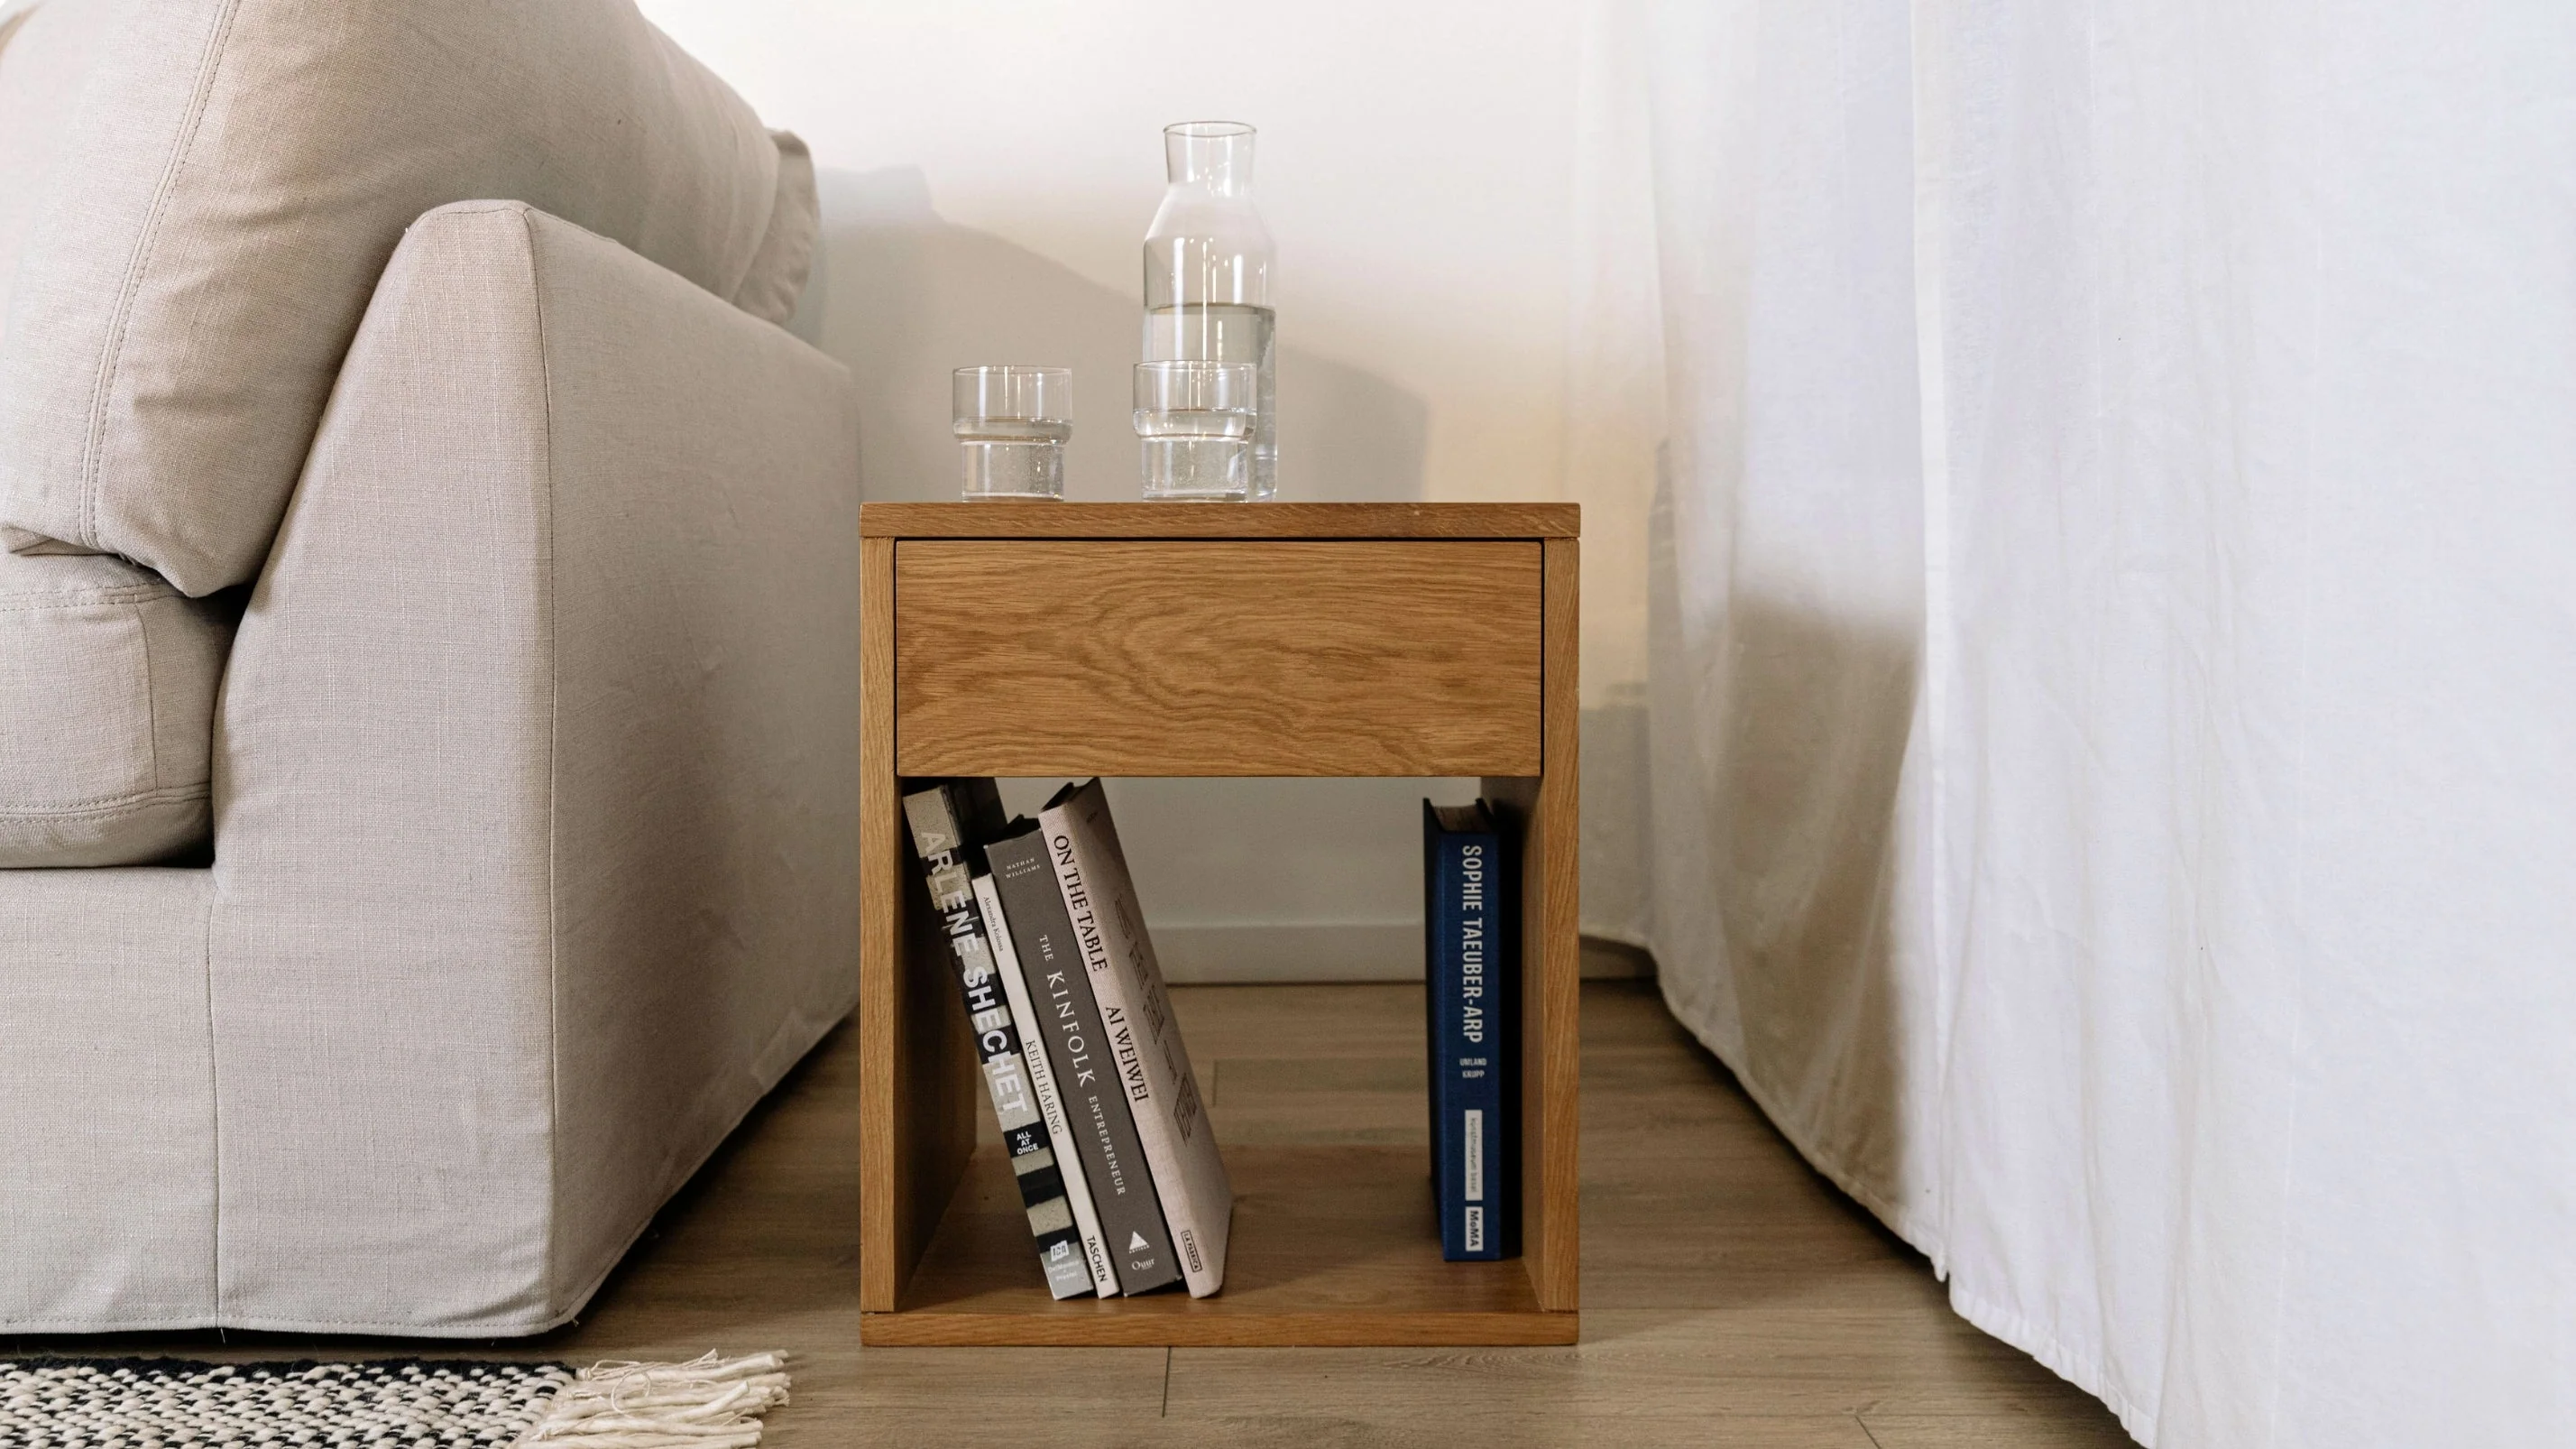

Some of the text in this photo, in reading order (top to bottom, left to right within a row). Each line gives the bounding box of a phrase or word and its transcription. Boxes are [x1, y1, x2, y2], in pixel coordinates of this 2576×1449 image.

[918, 831, 979, 957] ARLENE
[1005, 863, 1041, 880] WILLIAMS
[1006, 856, 1035, 872] NATHAN
[1053, 834, 1109, 973] ON THE TABLE
[1462, 844, 1484, 1044] SOPHIE TAEUBER-ARP
[962, 964, 1029, 1113] SHECHET
[1039, 934, 1127, 1196] THE KINFOLK ENTREPRENEUR
[1106, 1005, 1150, 1103] AI WEIWEI
[1026, 1039, 1063, 1135] KEITH HARING
[1016, 1131, 1032, 1143] ALL
[1017, 1143, 1039, 1156] ONCE
[1021, 1137, 1031, 1148] AT
[1087, 1235, 1108, 1283] TASCHEN
[1470, 1210, 1480, 1248] MoMA
